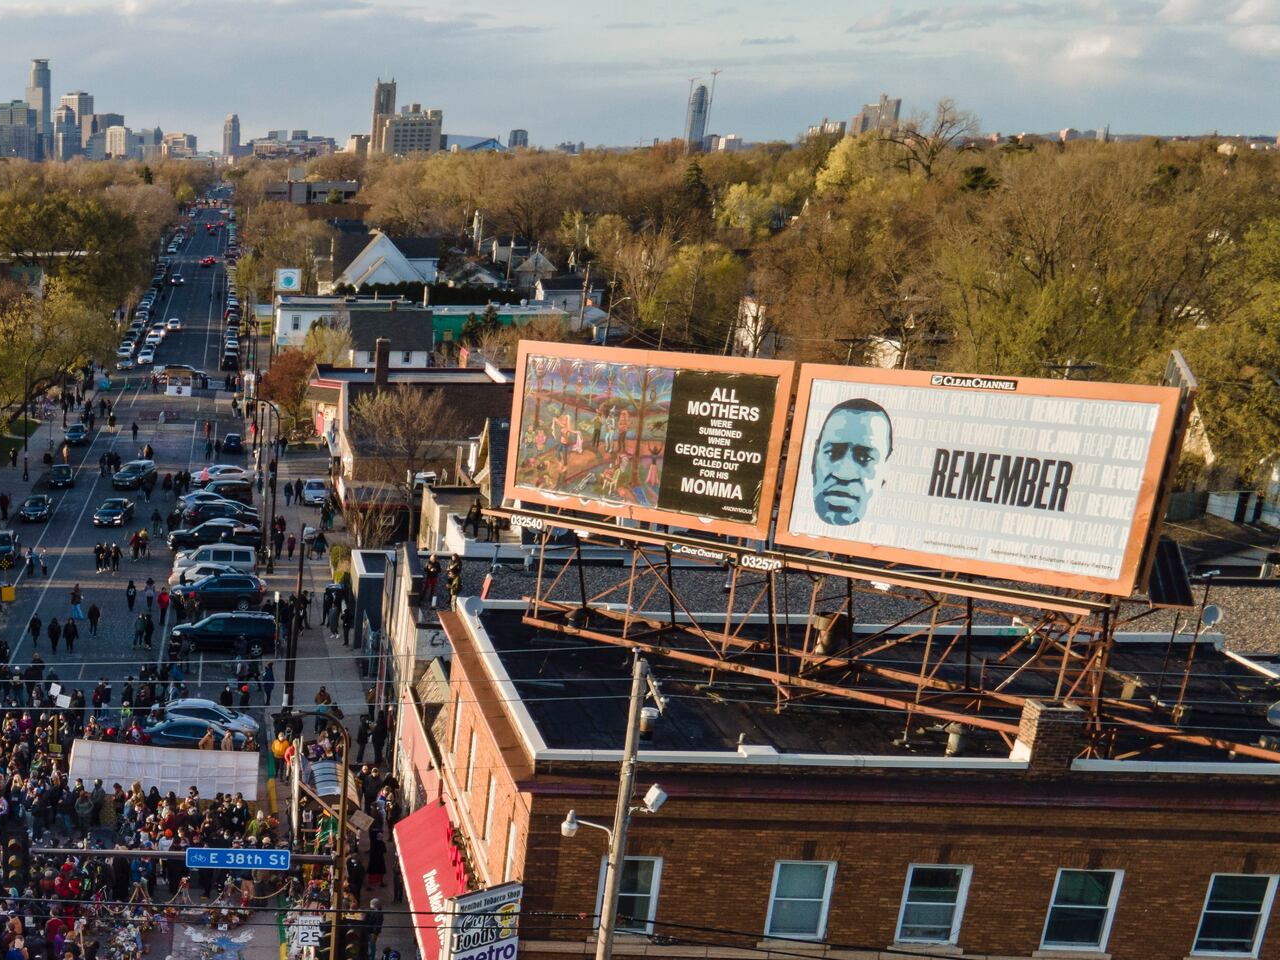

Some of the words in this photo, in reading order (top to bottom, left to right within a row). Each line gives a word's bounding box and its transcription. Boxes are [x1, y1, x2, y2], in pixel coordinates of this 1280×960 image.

[711, 388, 739, 403] ALL
[687, 401, 760, 421] MOTHERS
[710, 419, 733, 428] WERE
[699, 427, 742, 439] SUMMONED
[708, 437, 731, 446] WHEN
[675, 443, 721, 459] GEORGE
[724, 449, 761, 464] FLOYD
[692, 458, 722, 469] CALLED
[723, 462, 739, 471] OUT
[699, 469, 715, 478] FOR
[716, 471, 729, 480] HIS
[928, 449, 1073, 512] REMEMBER
[680, 477, 743, 500] MOMMA
[510, 514, 543, 530] 032540
[741, 555, 782, 571] 032570
[209, 853, 218, 864] E
[226, 853, 262, 865] 38th
[269, 854, 286, 866] St
[484, 894, 506, 906] Tobacco
[507, 890, 521, 900] Shop
[300, 931, 320, 943] 25
